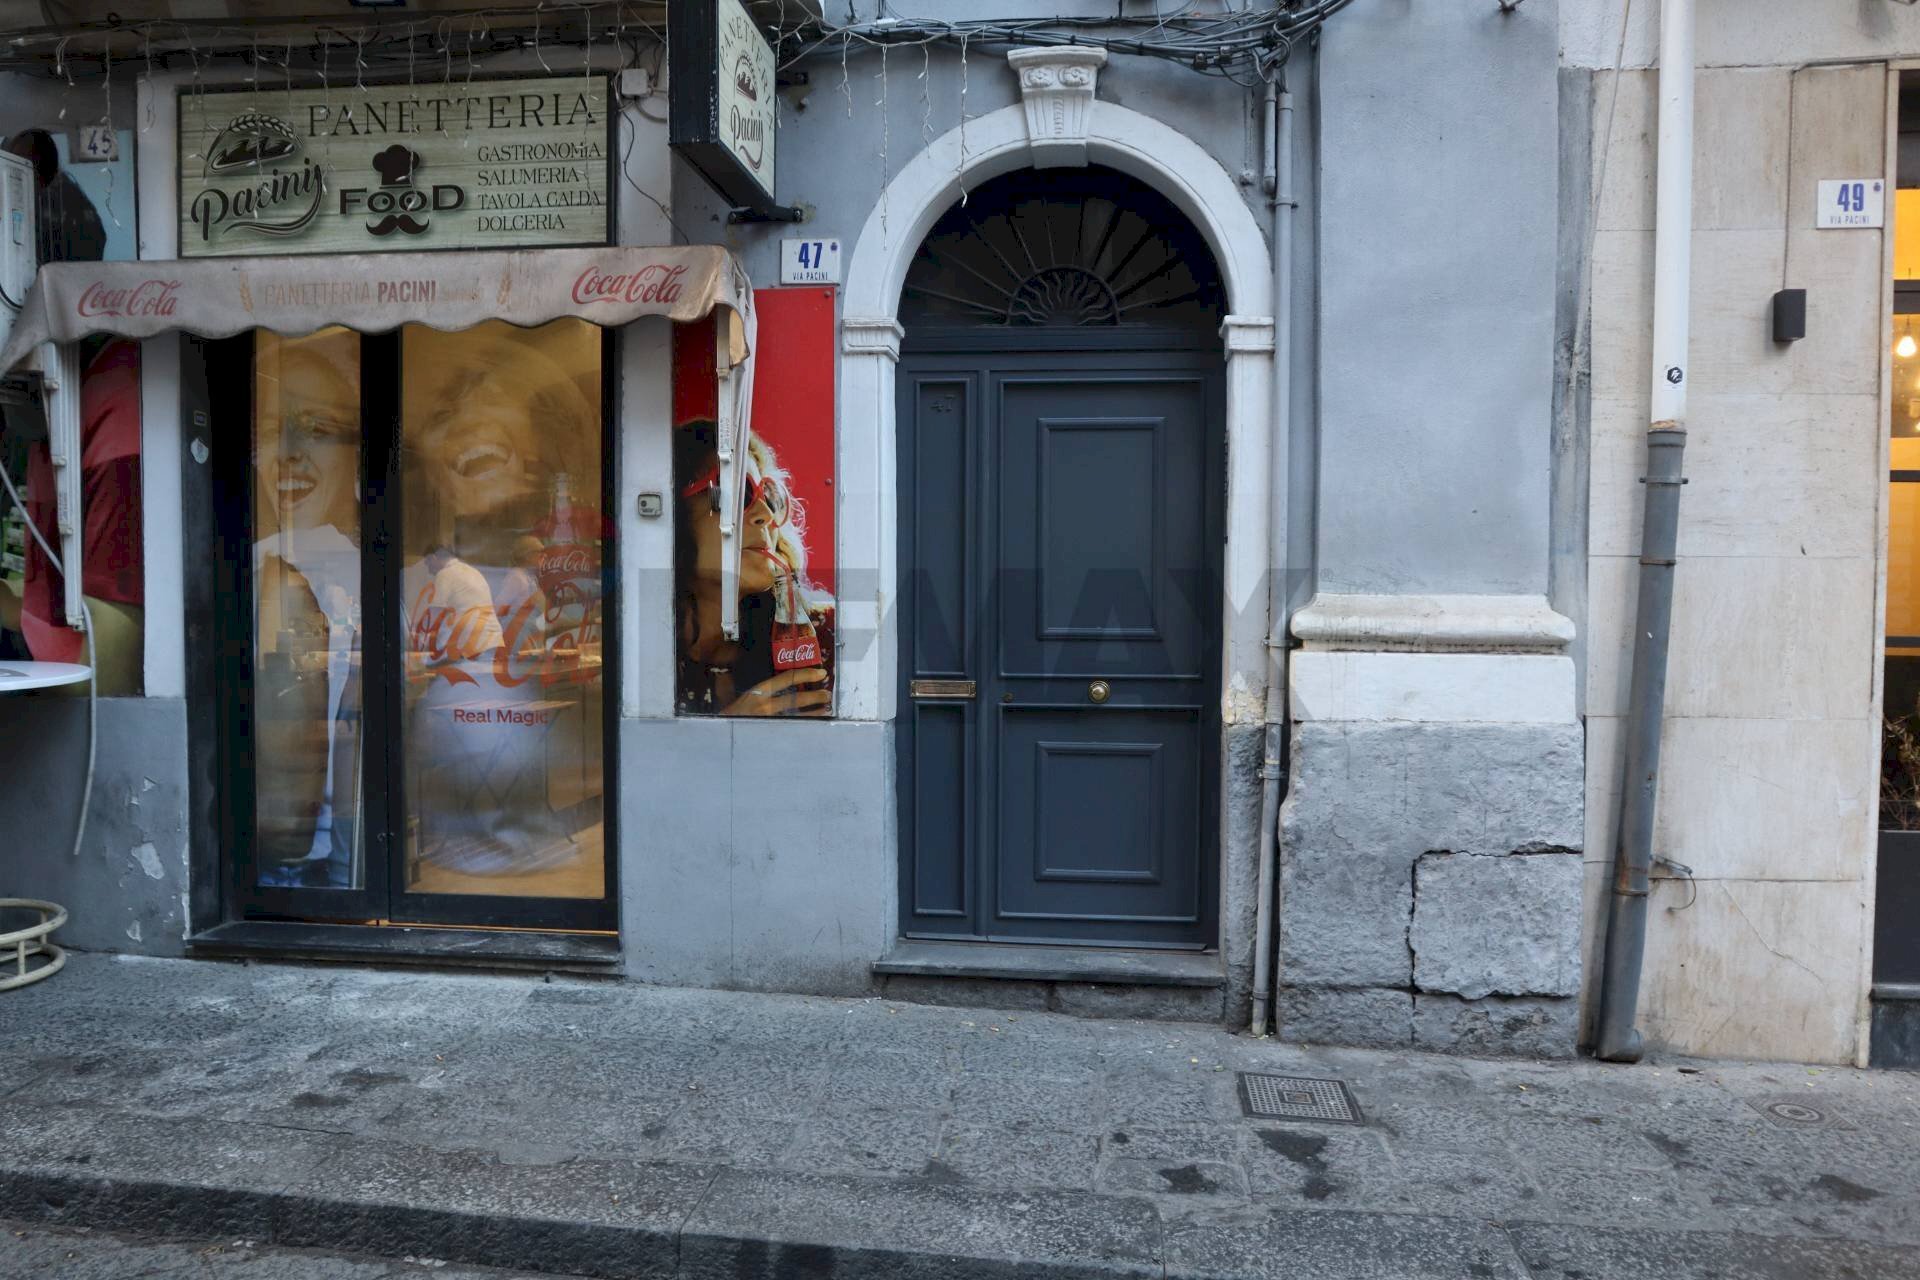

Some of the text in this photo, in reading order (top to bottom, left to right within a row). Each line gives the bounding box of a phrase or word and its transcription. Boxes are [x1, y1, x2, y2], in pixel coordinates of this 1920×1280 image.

[307, 92, 597, 137] PANETTERIA
[730, 104, 764, 152] Pacini
[87, 128, 113, 155] 45
[477, 141, 602, 162] GASTRONOMIA
[477, 166, 580, 186] SALUMERIA
[190, 157, 324, 241] Pacini
[477, 189, 603, 210] TAVOLA CALDA
[1837, 183, 1864, 212] 49
[477, 213, 566, 232] DOLCERIA
[1830, 215, 1870, 225] VIA PACINI
[798, 242, 823, 269] 47
[571, 264, 690, 305] Coca-Cola
[793, 271, 828, 281] VIA PACINI
[77, 279, 182, 318] Coca-Cola
[264, 279, 371, 305] PANETTERIA
[377, 279, 437, 303] PACINI
[777, 643, 816, 664] Coca-Cola
[454, 709, 548, 726] Real Magic
